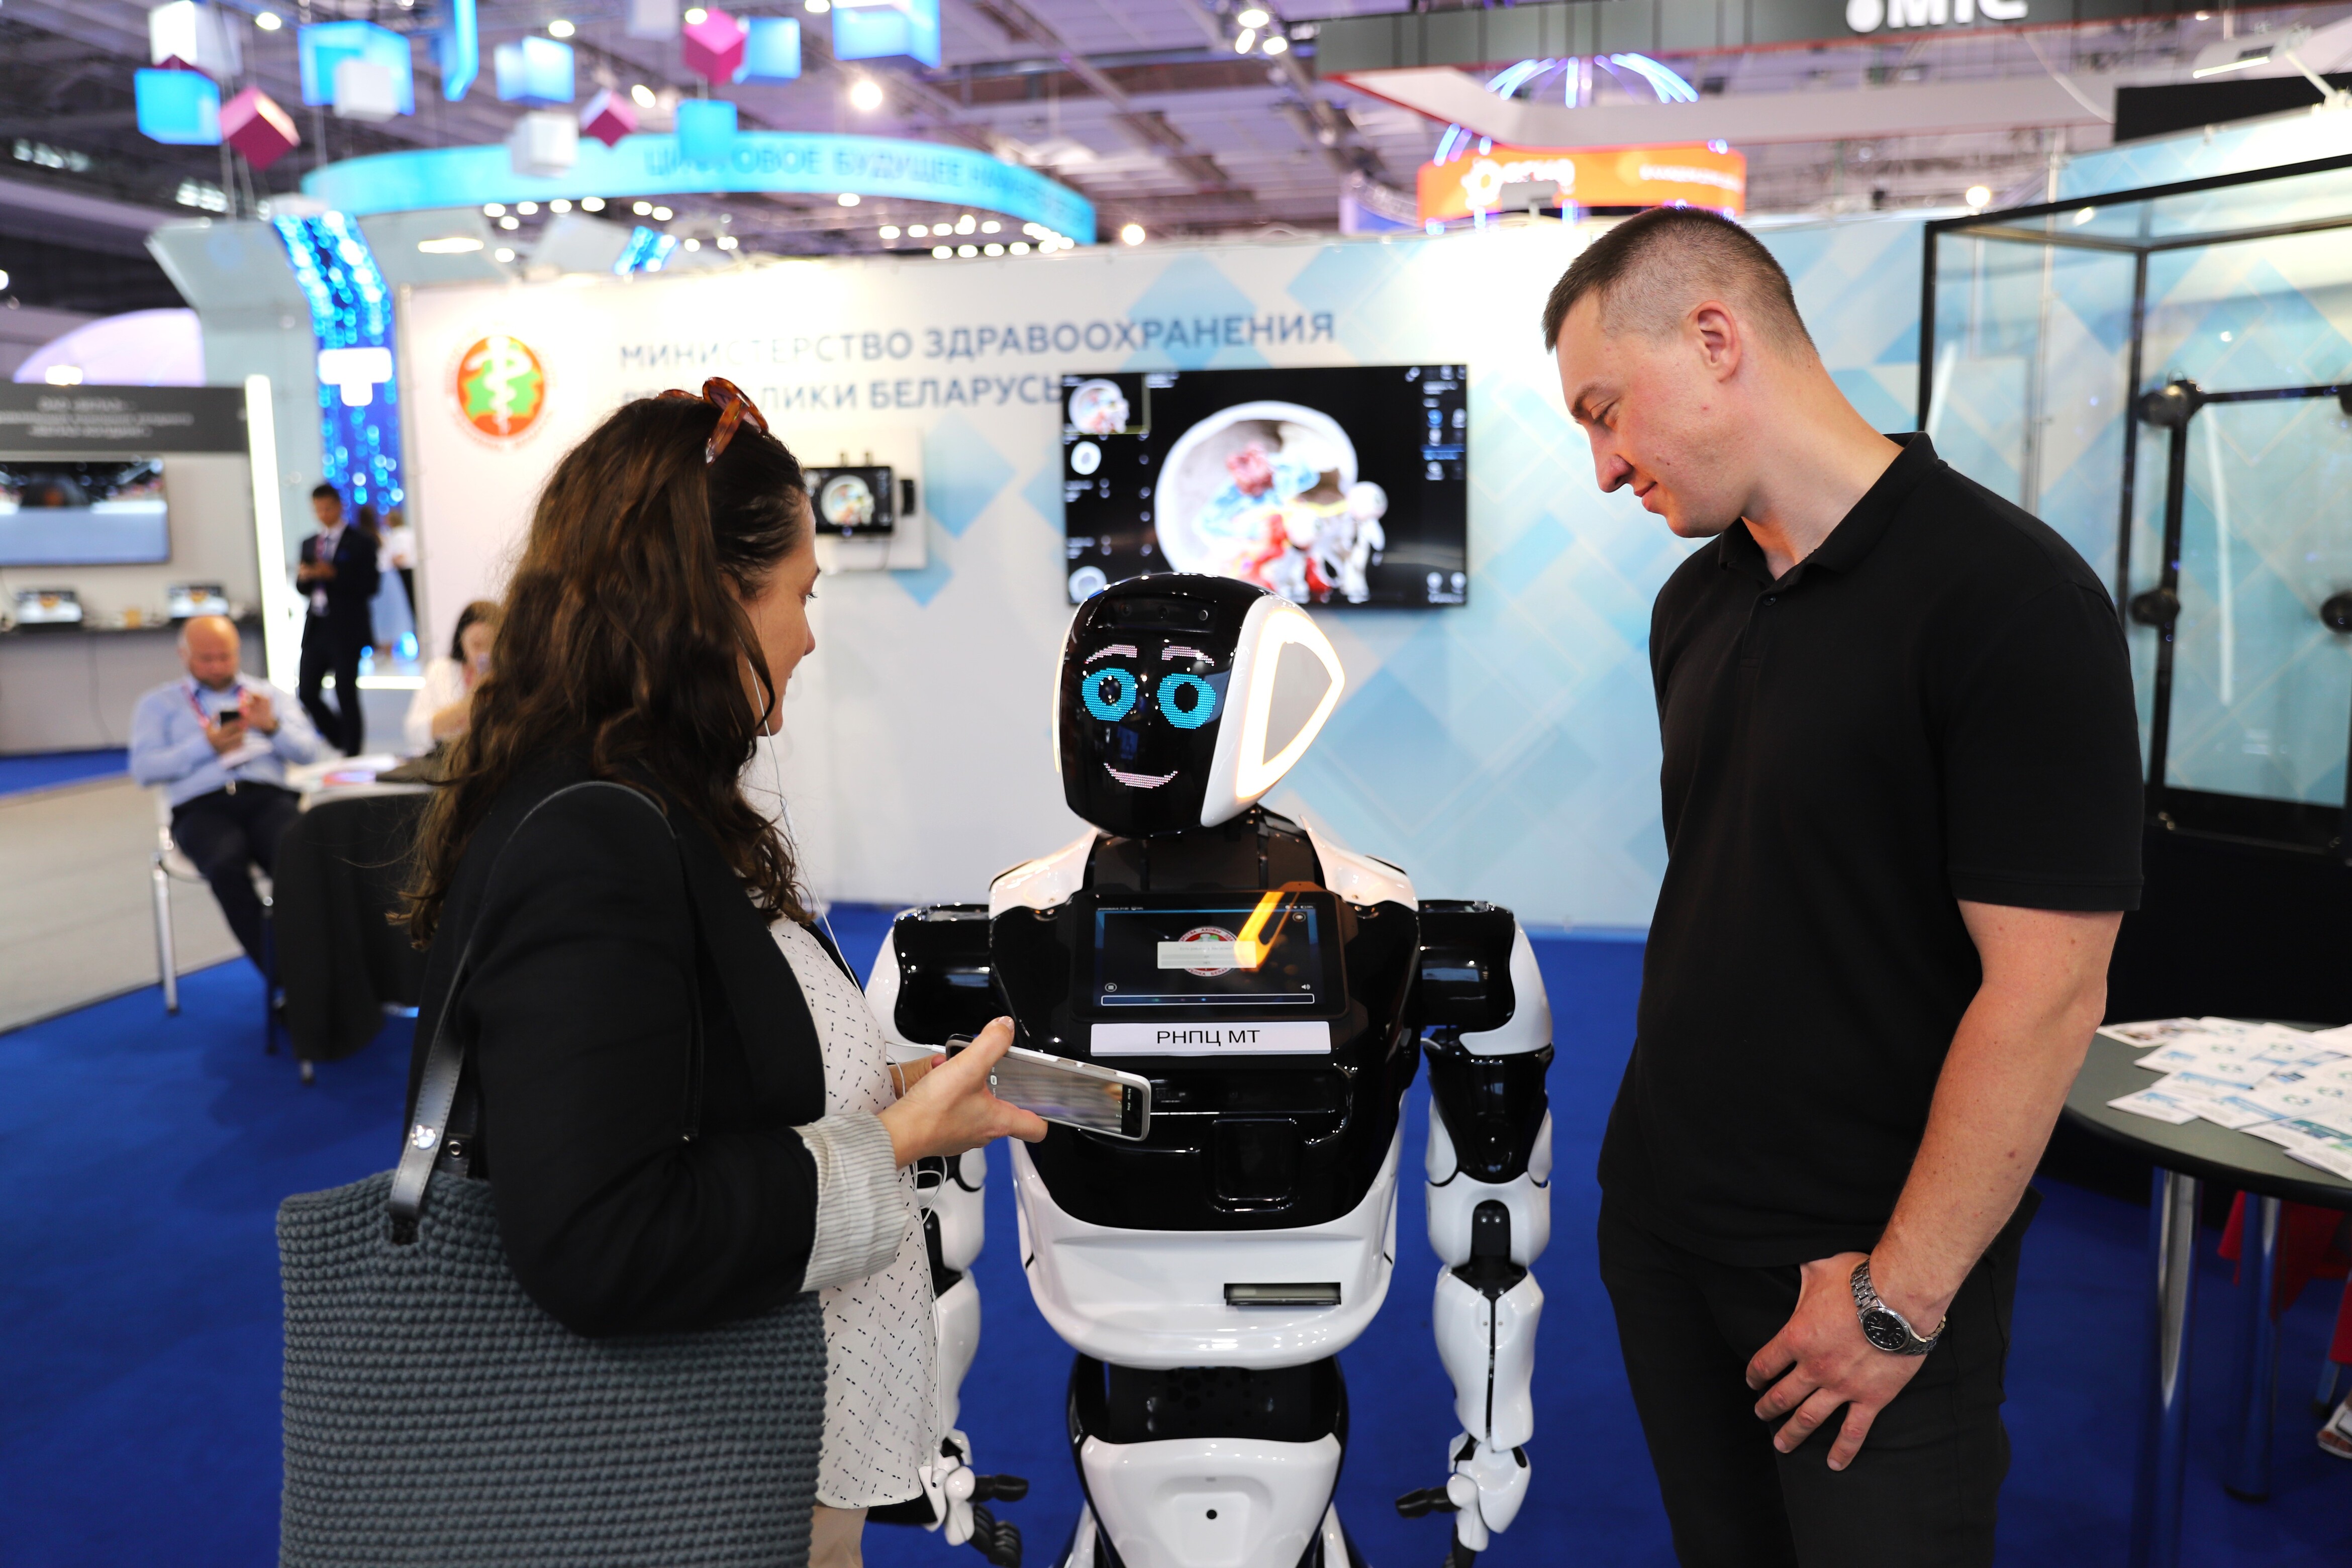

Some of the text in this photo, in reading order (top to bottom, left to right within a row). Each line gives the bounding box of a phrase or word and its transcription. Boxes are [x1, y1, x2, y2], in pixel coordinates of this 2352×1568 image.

[644, 143, 821, 177] ЦИОВОЕ
[925, 314, 1333, 361] ЗДРАВООХРАНЕНИЯ
[870, 375, 1062, 409] БЕЛАРУСЬ
[1157, 1030, 1260, 1046] РНПЦ МТ
